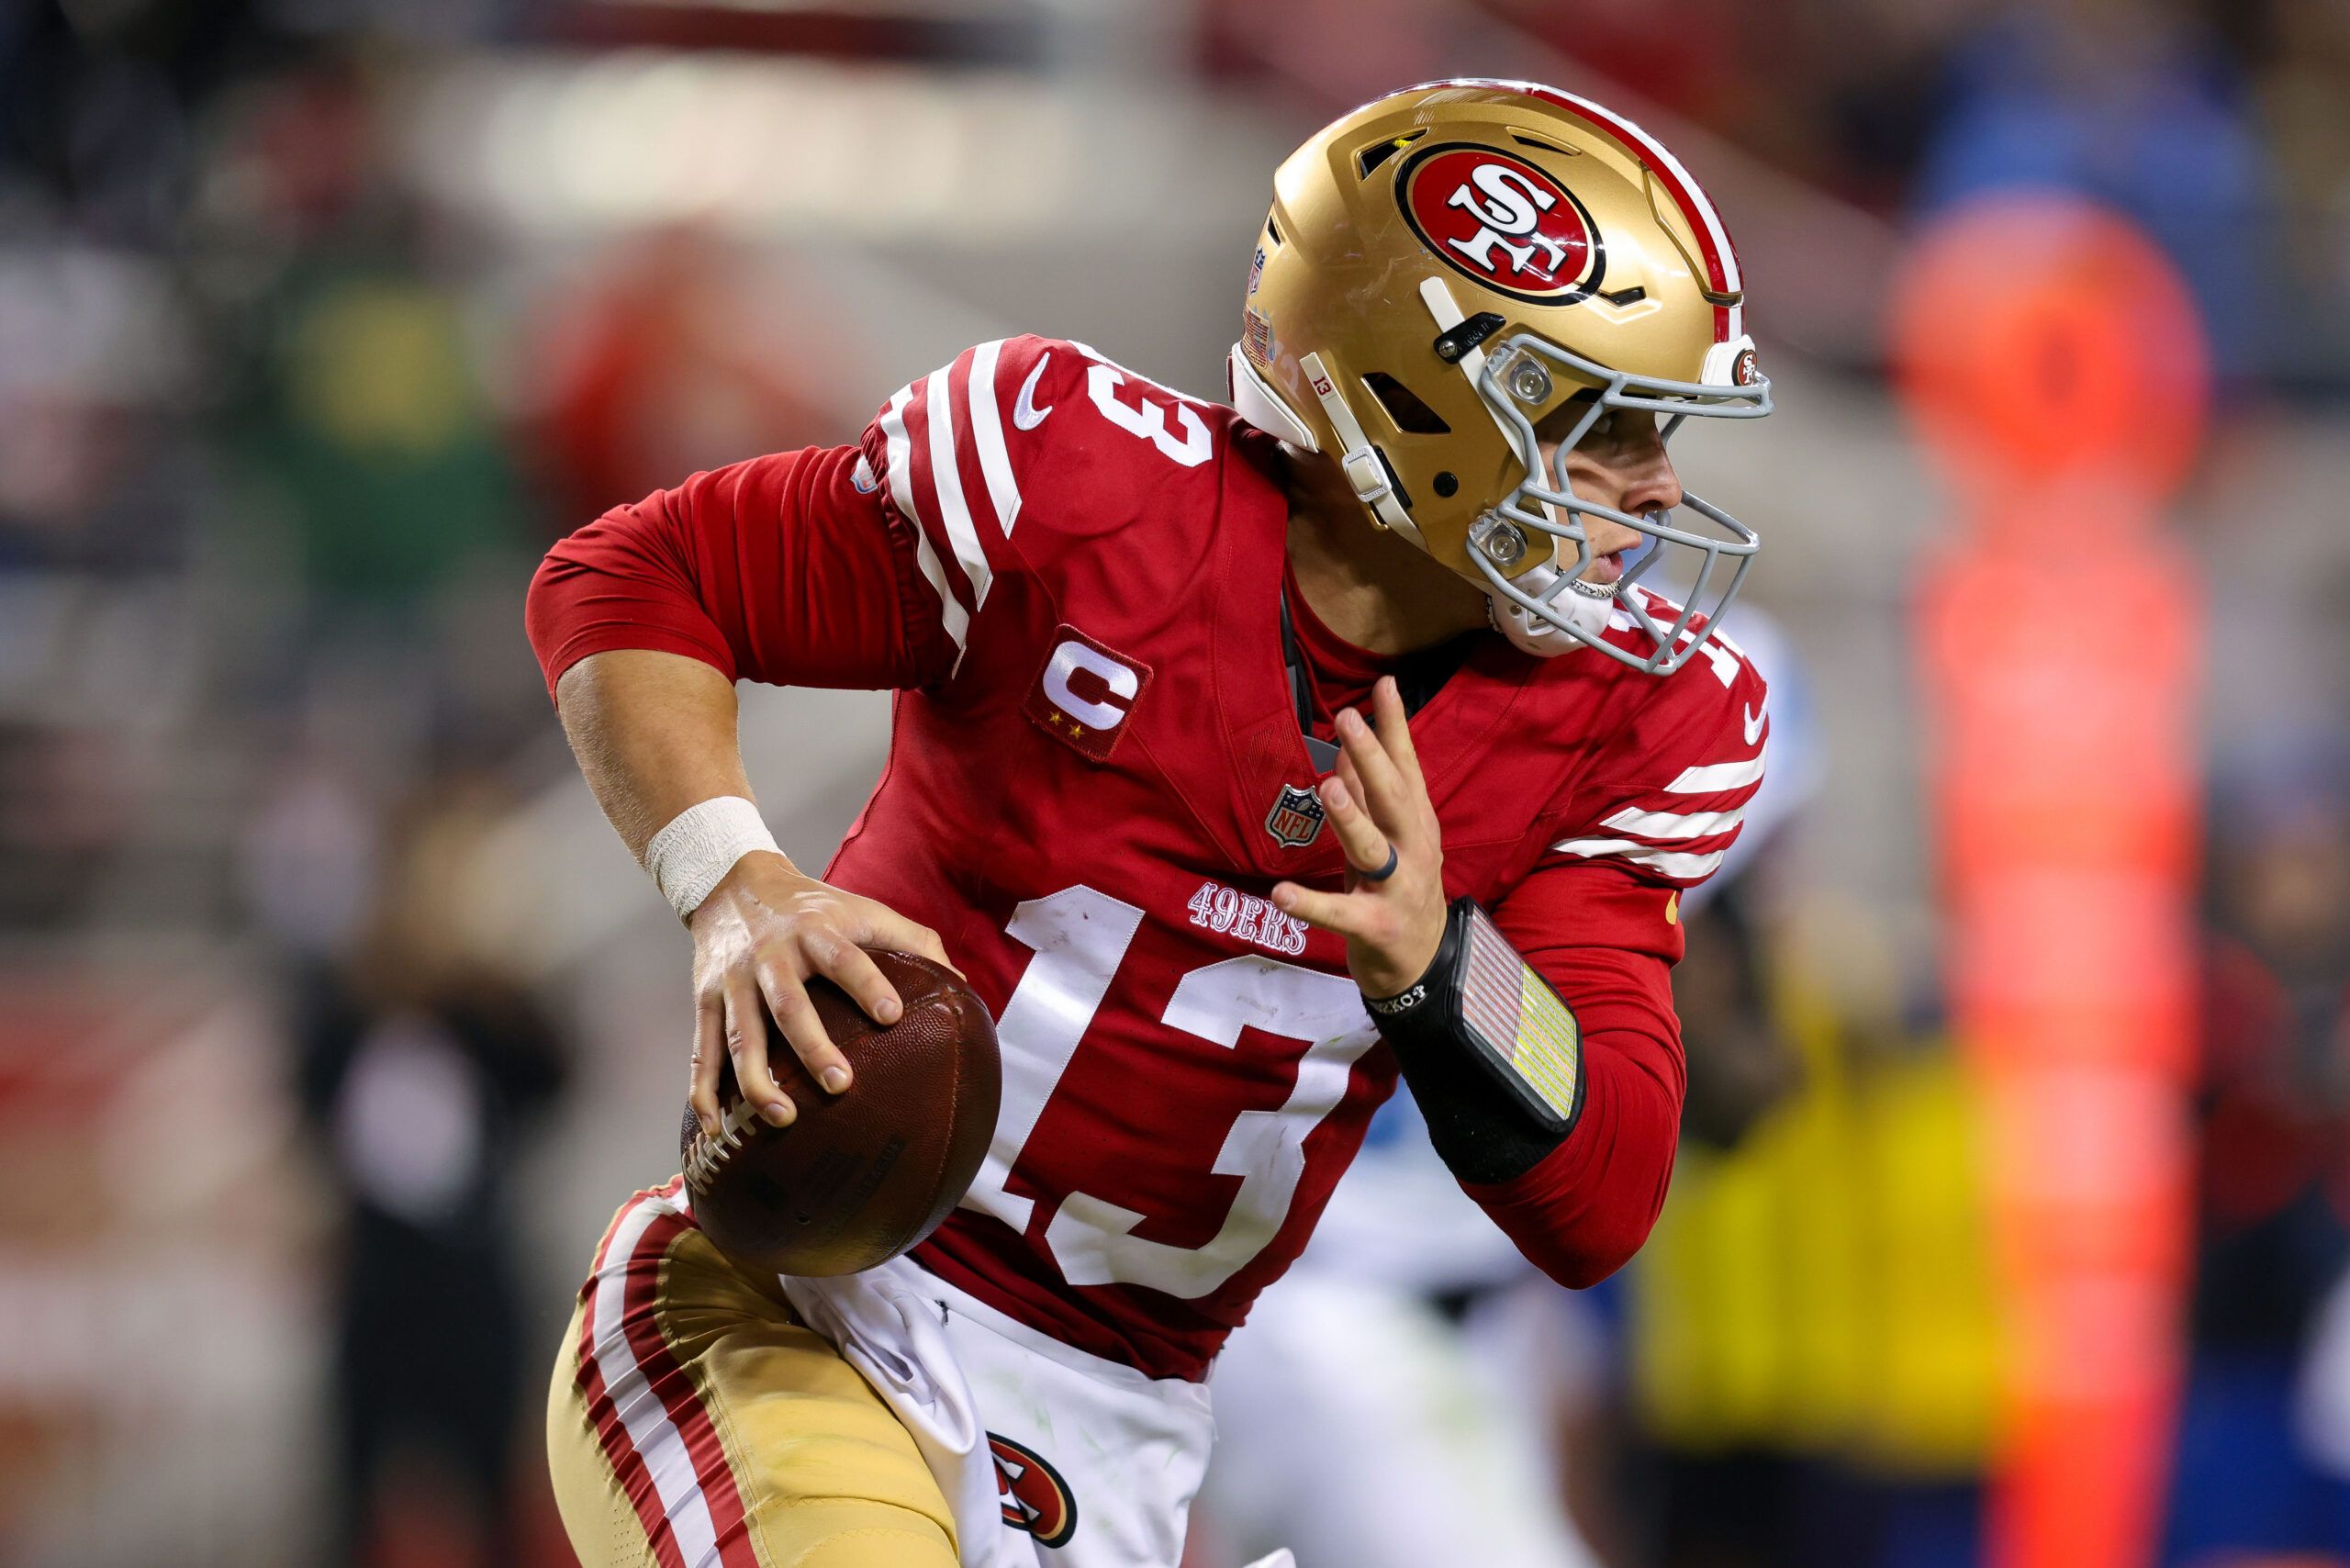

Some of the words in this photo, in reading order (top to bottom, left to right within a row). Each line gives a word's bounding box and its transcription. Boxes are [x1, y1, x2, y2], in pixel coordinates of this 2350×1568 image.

[1447, 163, 1568, 274] SF
[1313, 375, 1332, 396] 13
[1042, 641, 1138, 731] C
[1273, 809, 1313, 839] NFL
[1187, 881, 1310, 956] 49ERS
[958, 883, 1382, 1299] 13
